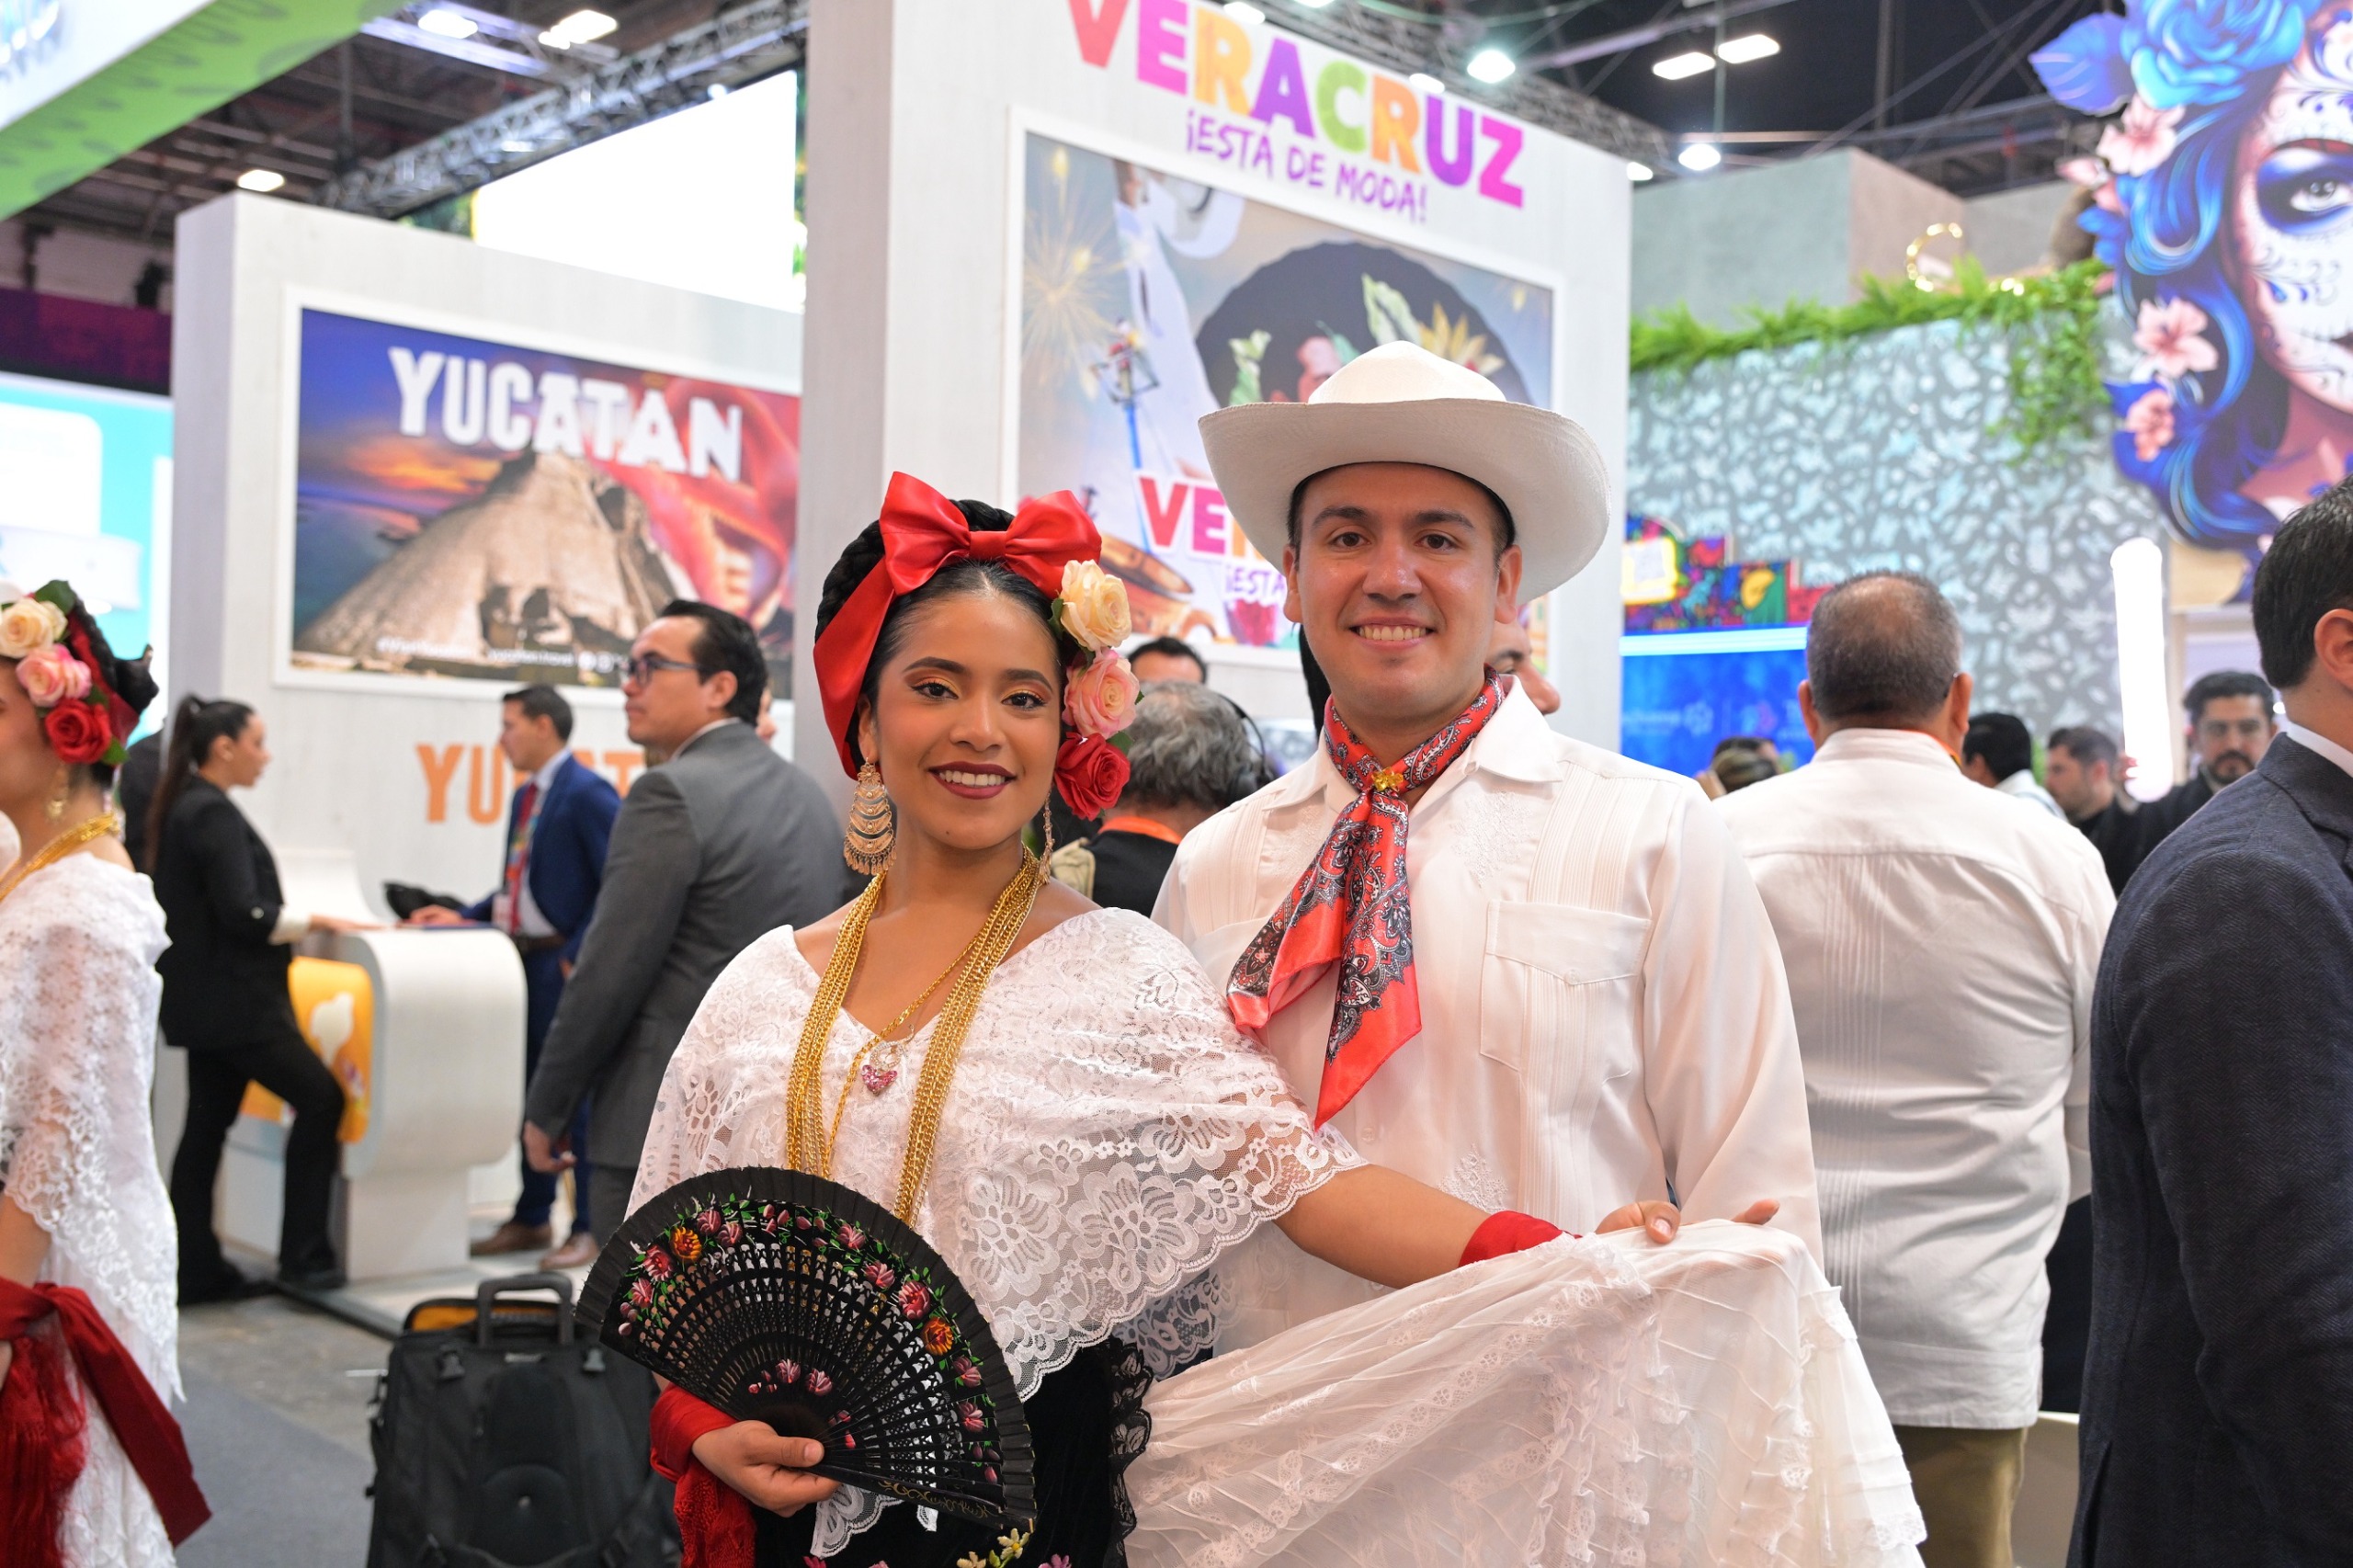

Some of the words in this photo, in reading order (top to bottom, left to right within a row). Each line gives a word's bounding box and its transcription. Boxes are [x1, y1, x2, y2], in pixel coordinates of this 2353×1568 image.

[1067, 0, 1523, 208] VERACRUZ
[1287, 145, 1325, 187] DE
[1335, 162, 1427, 223] MODA!
